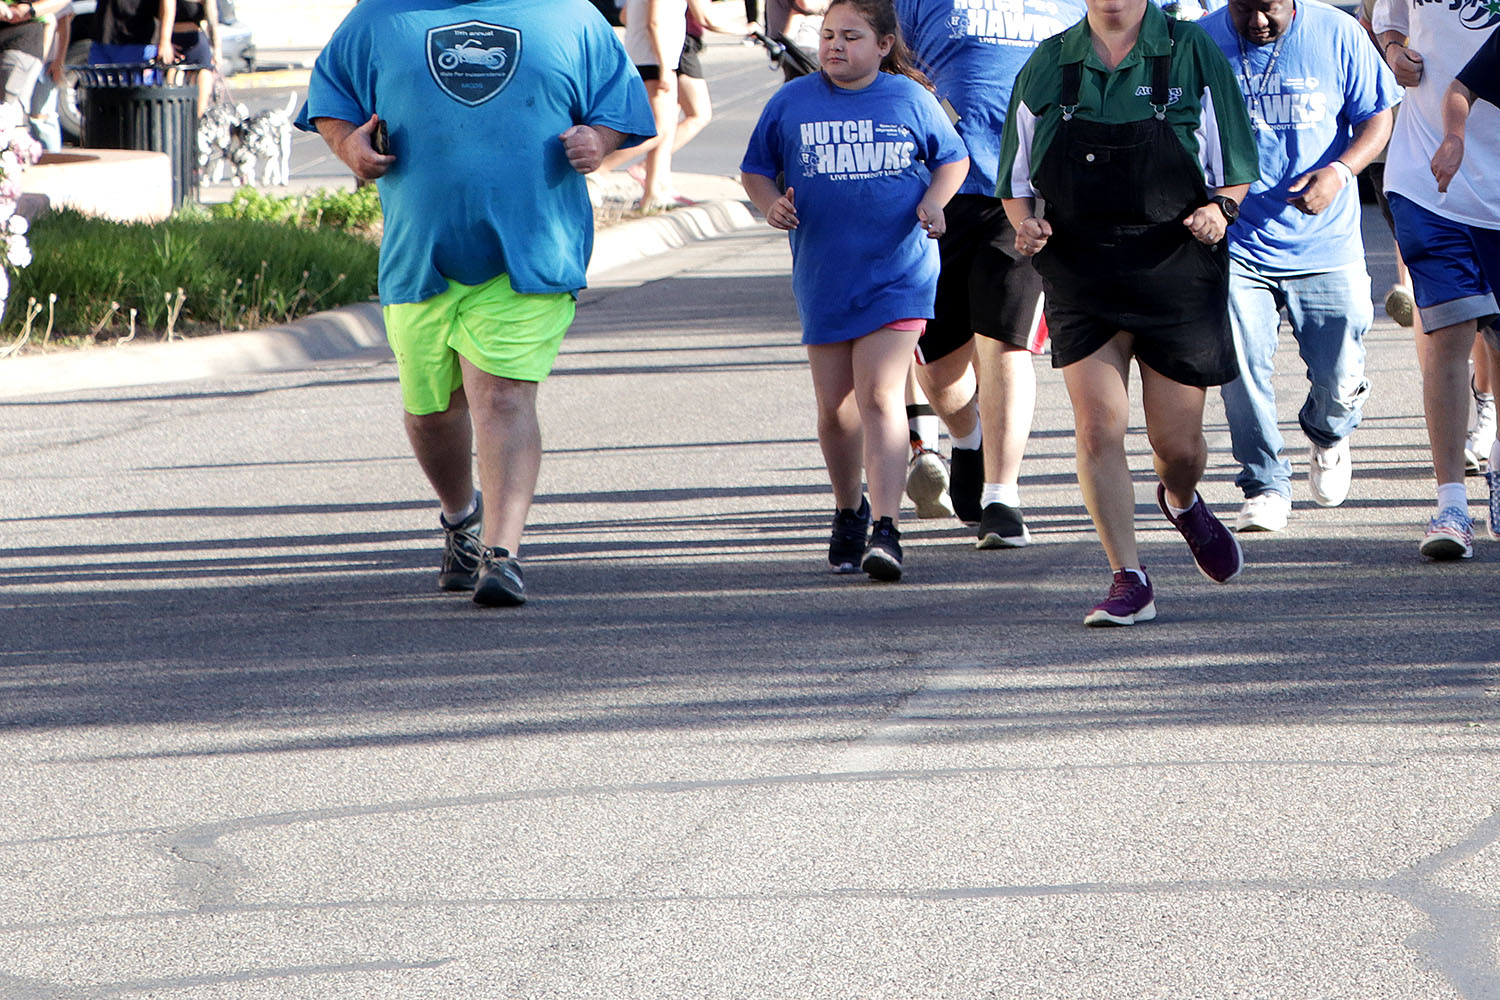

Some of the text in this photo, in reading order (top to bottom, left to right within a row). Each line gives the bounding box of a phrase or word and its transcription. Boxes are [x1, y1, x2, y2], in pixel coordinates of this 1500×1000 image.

[800, 119, 874, 146] HUTCH
[815, 141, 915, 174] HAWKS
[829, 173, 848, 181] LIVE
[848, 170, 884, 180] WITHOUT
